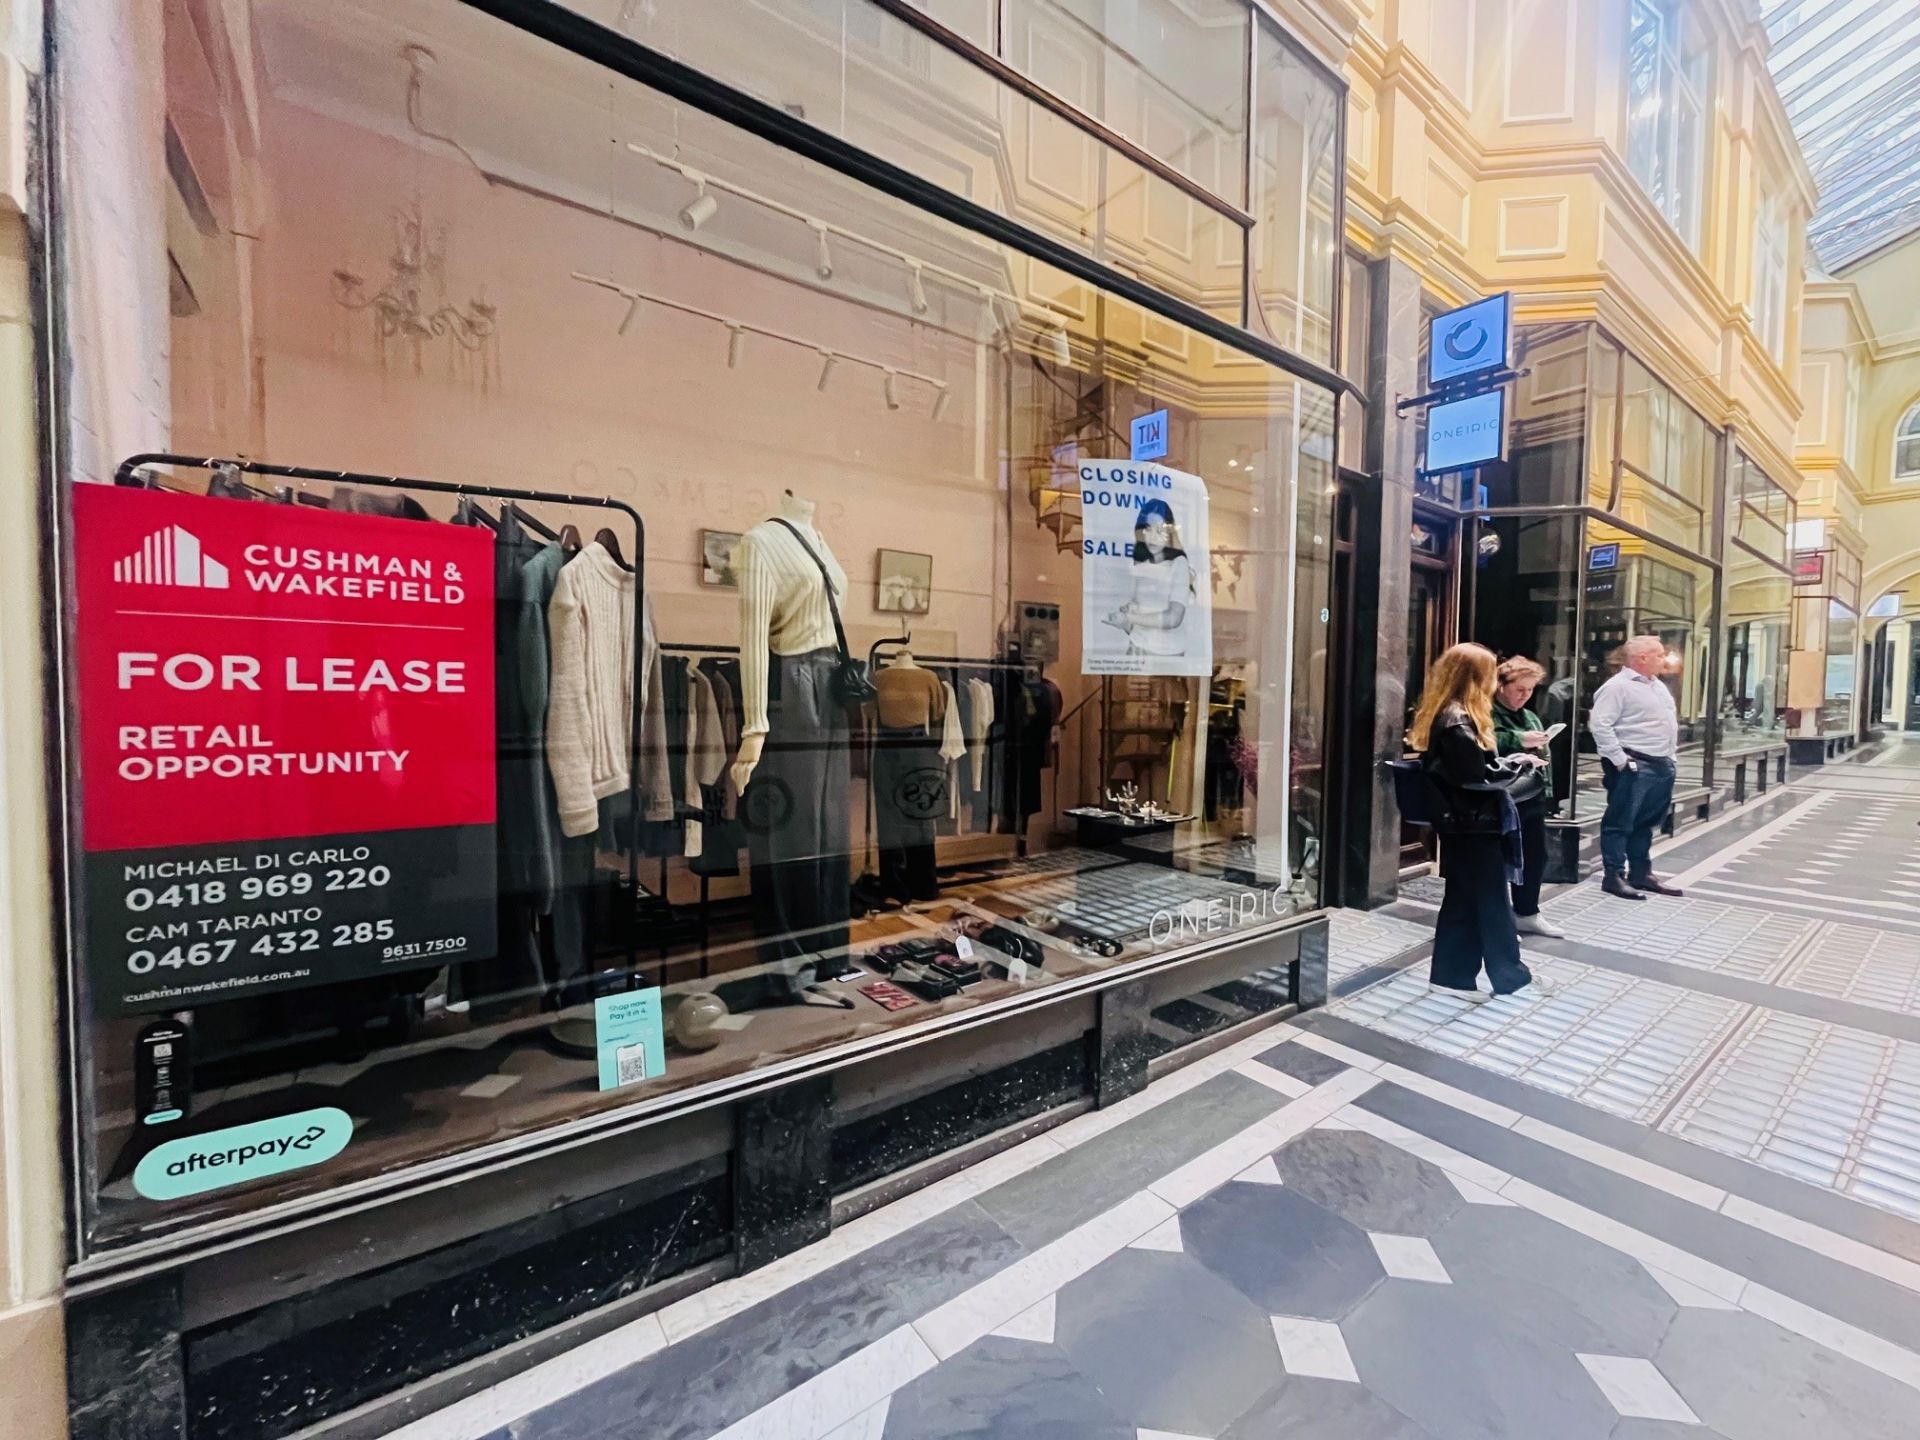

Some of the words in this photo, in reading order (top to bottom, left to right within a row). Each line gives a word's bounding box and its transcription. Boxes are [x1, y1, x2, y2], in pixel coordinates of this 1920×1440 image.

[1432, 418, 1498, 442] ONEIRIC
[1080, 466, 1172, 489] CLOSING
[1082, 490, 1147, 511] DOWN
[244, 544, 431, 579] CUSHMAN
[443, 562, 464, 581] &
[1084, 539, 1134, 558] SALE
[244, 569, 465, 604] WAKEFIELD
[117, 651, 262, 691] FOR
[286, 656, 465, 693] LEASE
[119, 724, 273, 751] RETAIL
[118, 749, 409, 781] OPPORTUNITY
[124, 856, 247, 881] MICHAEL
[255, 853, 280, 869] DI
[288, 846, 370, 866] CARLO
[125, 880, 226, 912] 0418
[240, 872, 313, 900] 969
[325, 865, 391, 891] 220
[125, 922, 189, 943] CAM
[197, 907, 322, 934] TARANTO
[1149, 885, 1287, 945] ONEIRIC
[127, 938, 237, 974] 0467
[250, 929, 320, 956] 432
[332, 919, 394, 947] 285
[383, 943, 420, 958] 9631
[425, 936, 467, 952] 7500
[124, 967, 310, 1003] cushmanwakefield.com.au
[608, 1002, 629, 1012] Shop
[630, 1000, 647, 1008] now
[609, 1011, 625, 1021] Pay
[166, 1136, 294, 1177] afterpay
